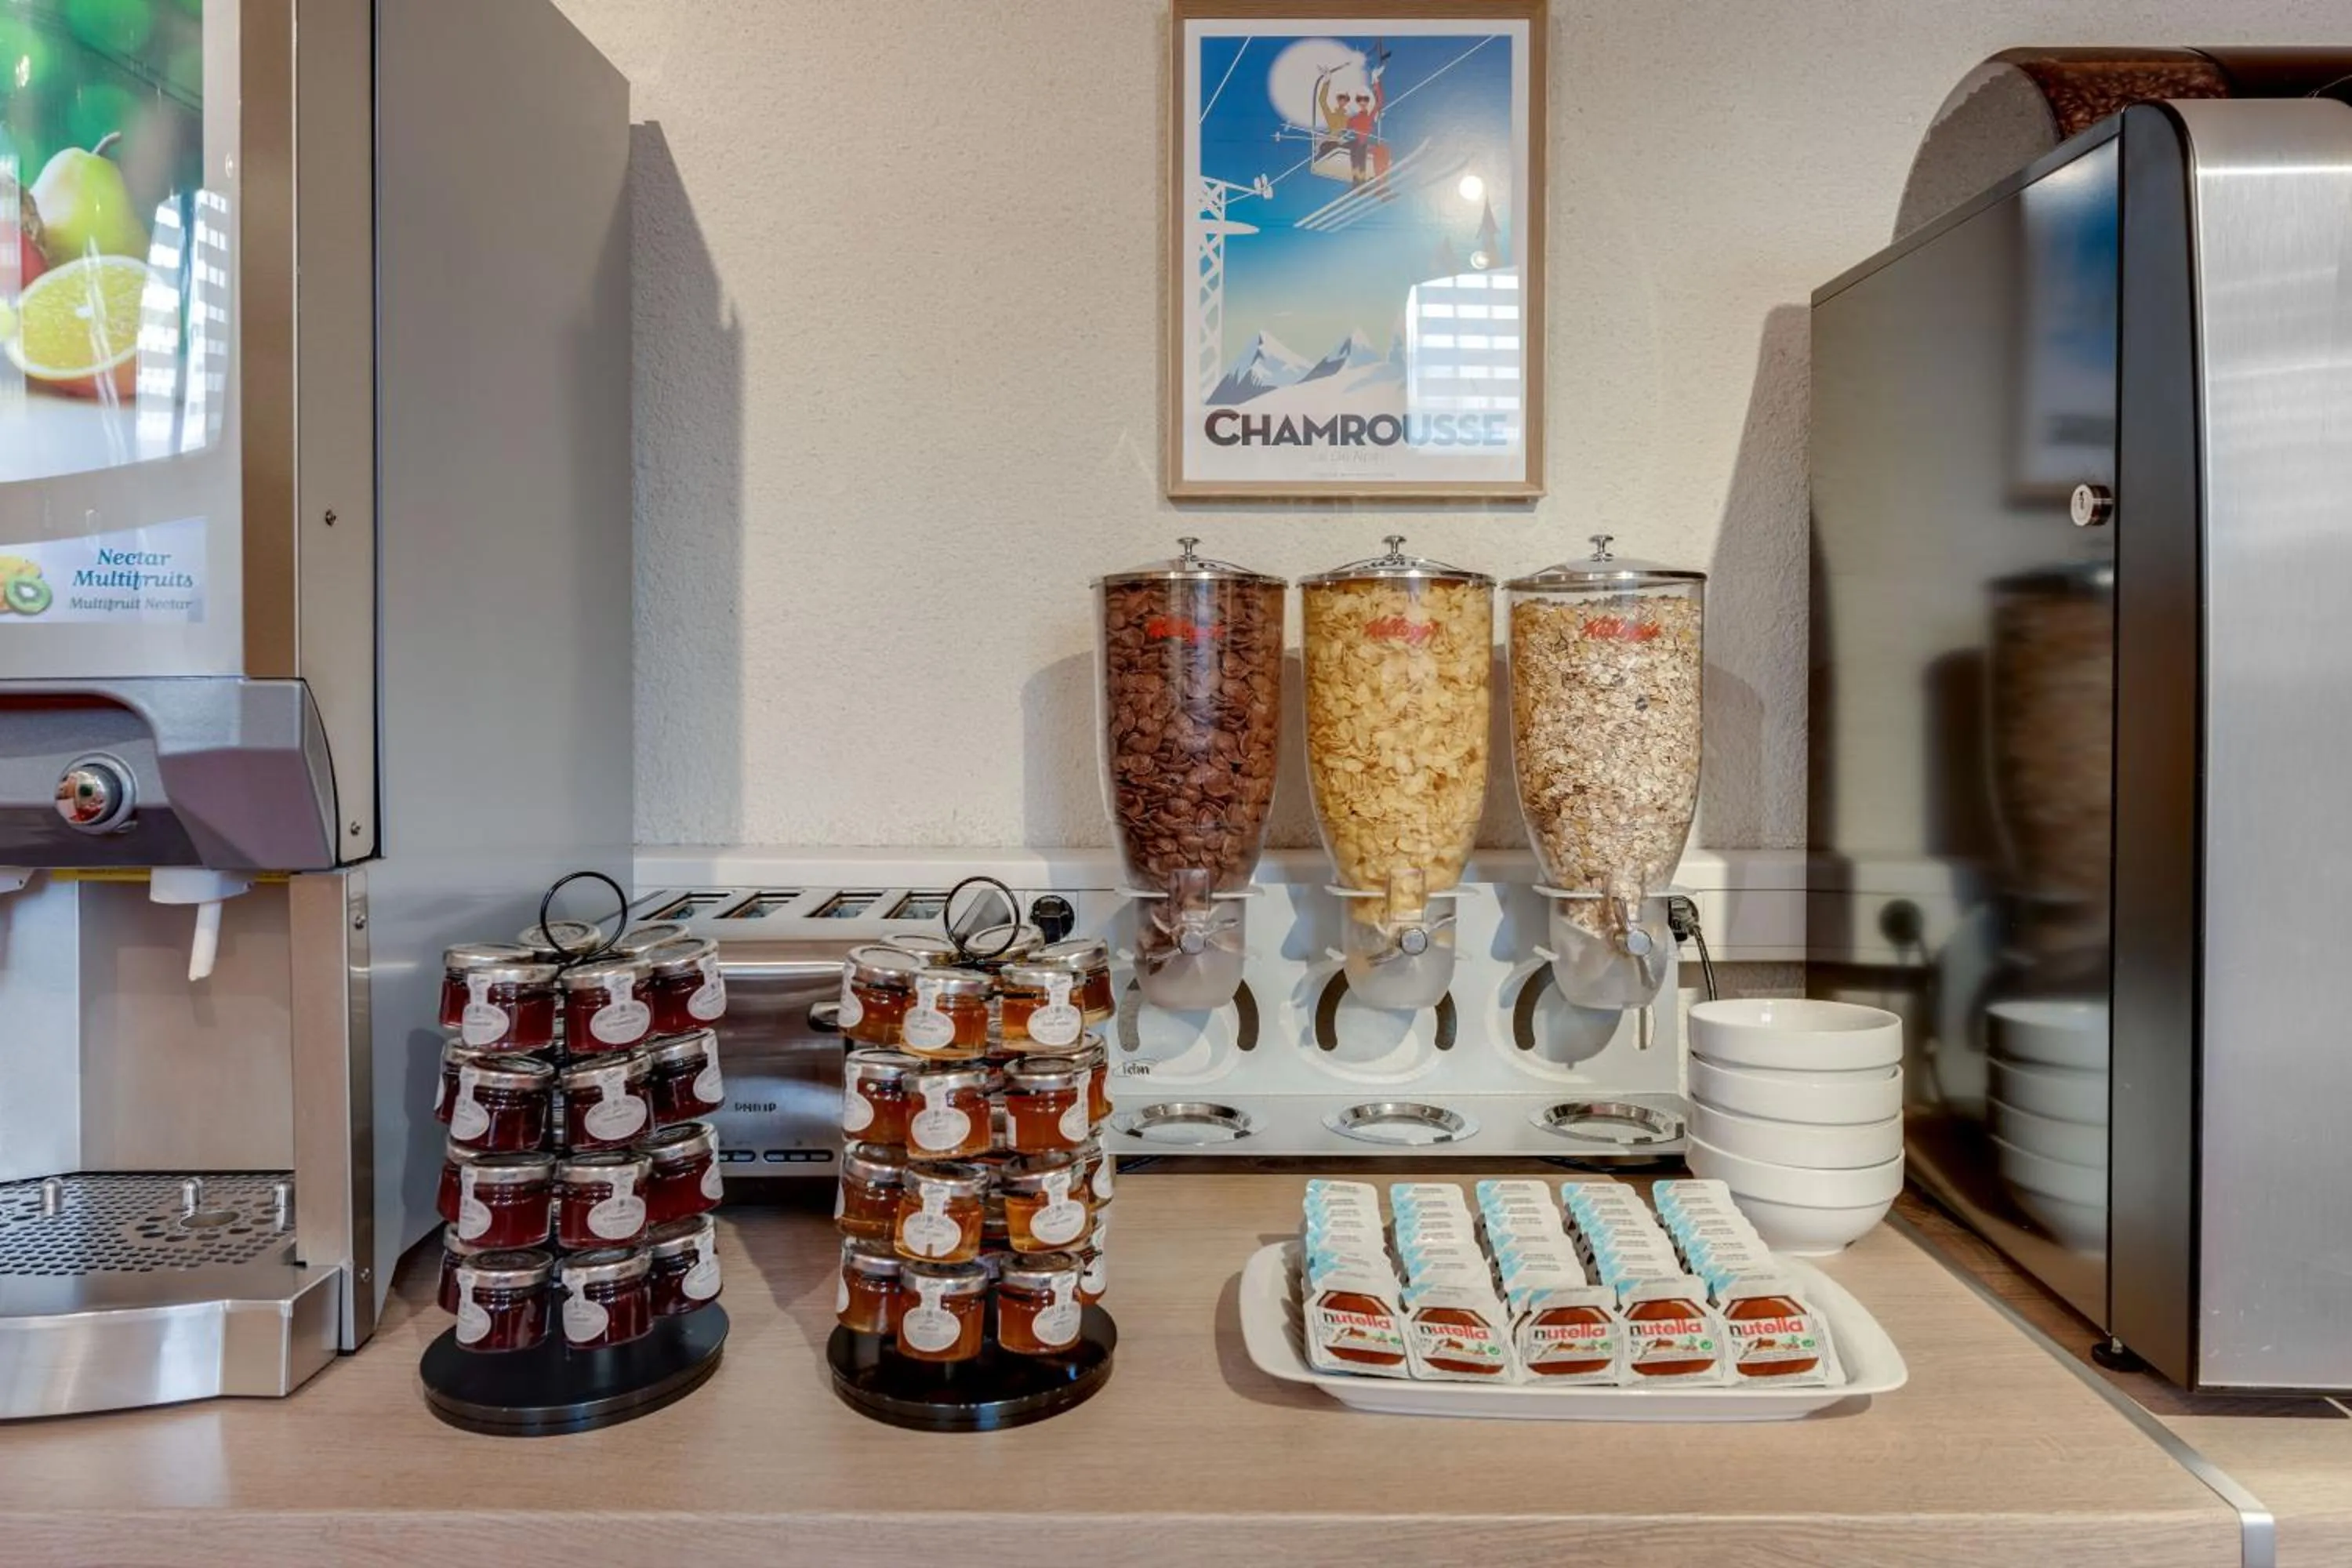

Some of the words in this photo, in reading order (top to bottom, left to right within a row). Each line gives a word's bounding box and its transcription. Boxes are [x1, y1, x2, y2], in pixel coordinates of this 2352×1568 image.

[1204, 408, 1508, 447] CHAMROUSSE
[97, 549, 172, 565] Nectar
[72, 570, 194, 590] Multifruits
[70, 597, 141, 612] Multifruit
[144, 597, 193, 610] Nectar
[1323, 1309, 1392, 1330] nutella
[1630, 1317, 1703, 1336] nutella
[1729, 1315, 1804, 1336] nutella
[1419, 1323, 1489, 1341] nutella
[1534, 1320, 1606, 1340] nutella
